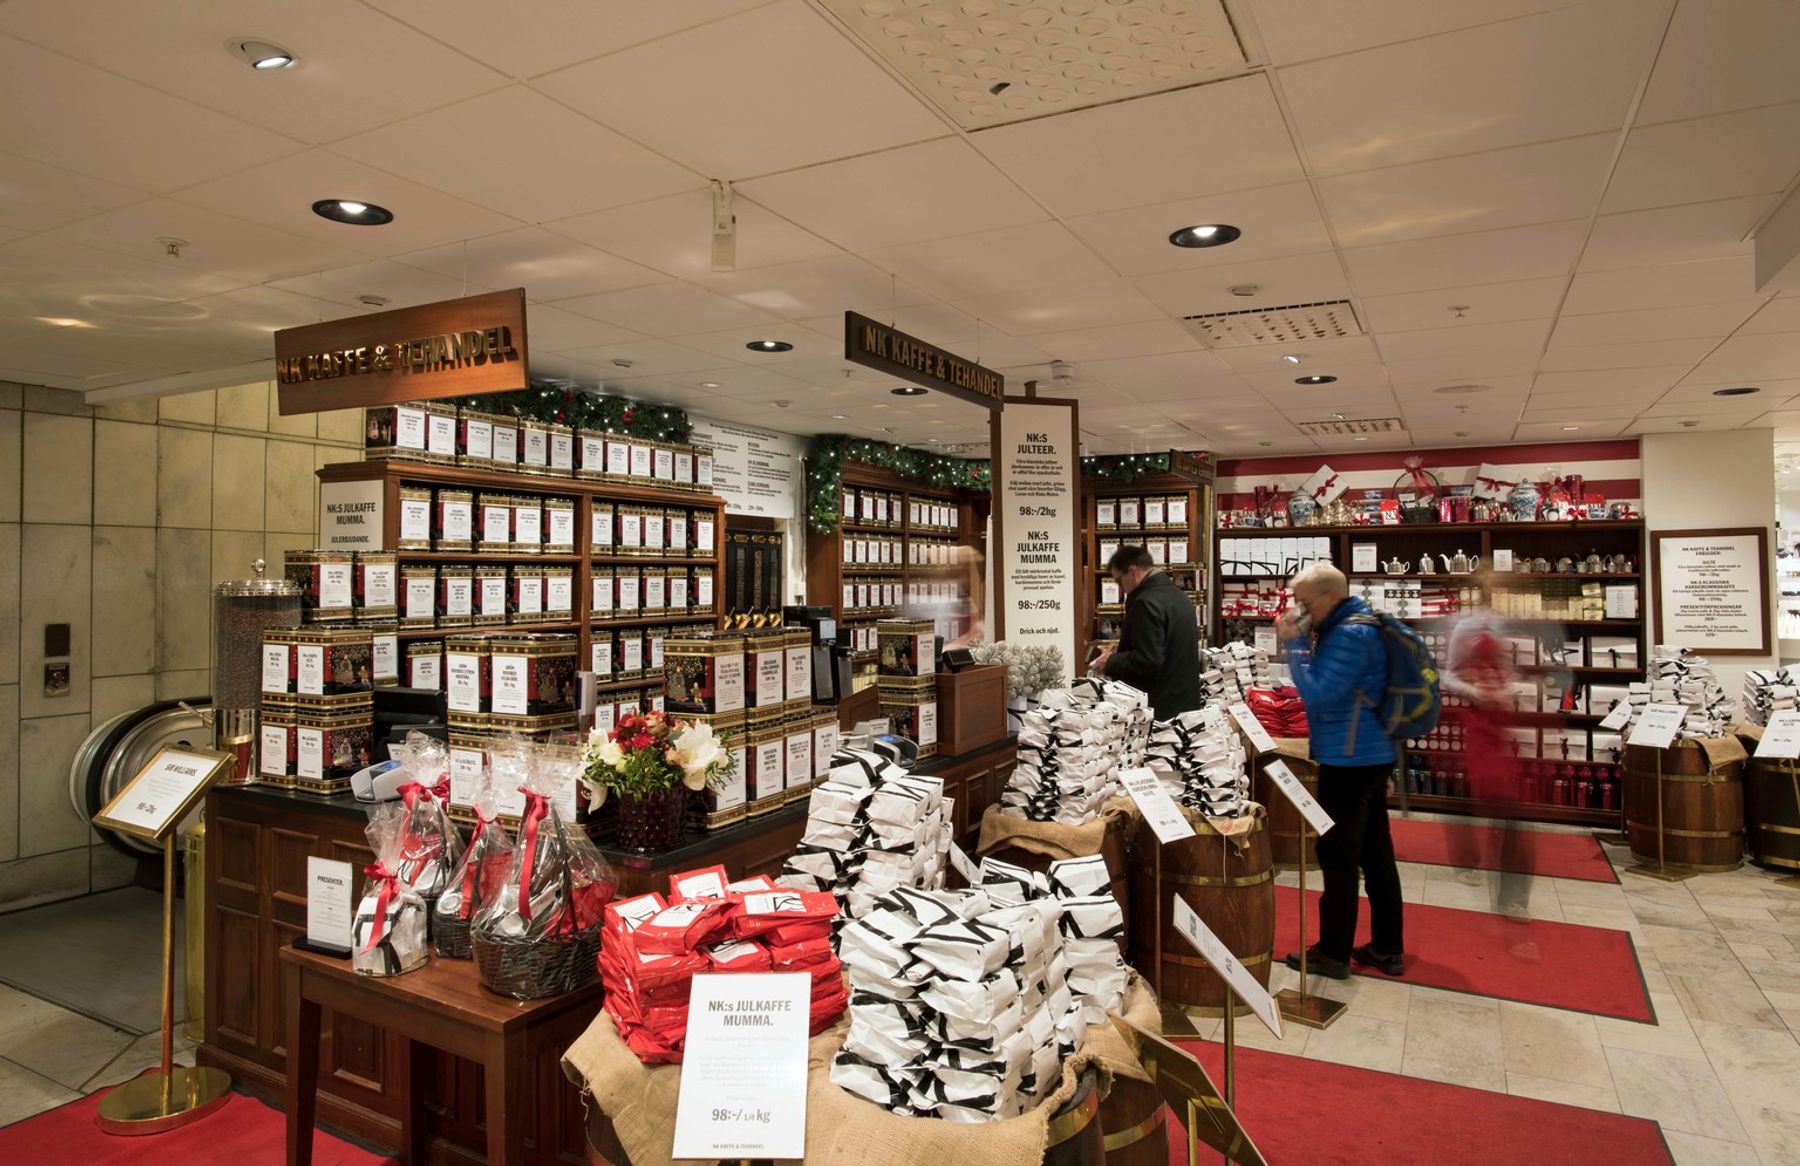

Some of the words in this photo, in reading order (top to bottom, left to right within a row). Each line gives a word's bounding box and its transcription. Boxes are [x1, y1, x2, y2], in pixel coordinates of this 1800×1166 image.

[278, 357, 304, 384] NK
[306, 346, 366, 380] KAFFE
[373, 343, 394, 371] &
[395, 325, 516, 373] TEHANDEL
[864, 325, 887, 358] NK
[892, 336, 933, 375] KAFFE
[936, 355, 946, 380] &
[949, 359, 1003, 400] TEHANDEL
[1026, 433, 1048, 443] NK:S
[1017, 444, 1056, 454] JULTEER.
[327, 503, 343, 514] NK:S
[344, 502, 376, 513] JULKAFFE
[1019, 506, 1056, 517] 98:-/2hg
[336, 515, 365, 525] MUMMA.
[1028, 530, 1049, 540] NK:S
[1016, 542, 1060, 552] JULKAFFE
[1020, 554, 1057, 564] MUMMA
[1018, 600, 1061, 610] 98:-/250g
[318, 875, 344, 886] PRESENTER.
[708, 1000, 734, 1012] NK:s
[736, 1000, 792, 1012] JULKAFFE
[723, 1014, 774, 1026] MUMMA.
[712, 1108, 743, 1122] 98:-/
[756, 1109, 771, 1124] kg
